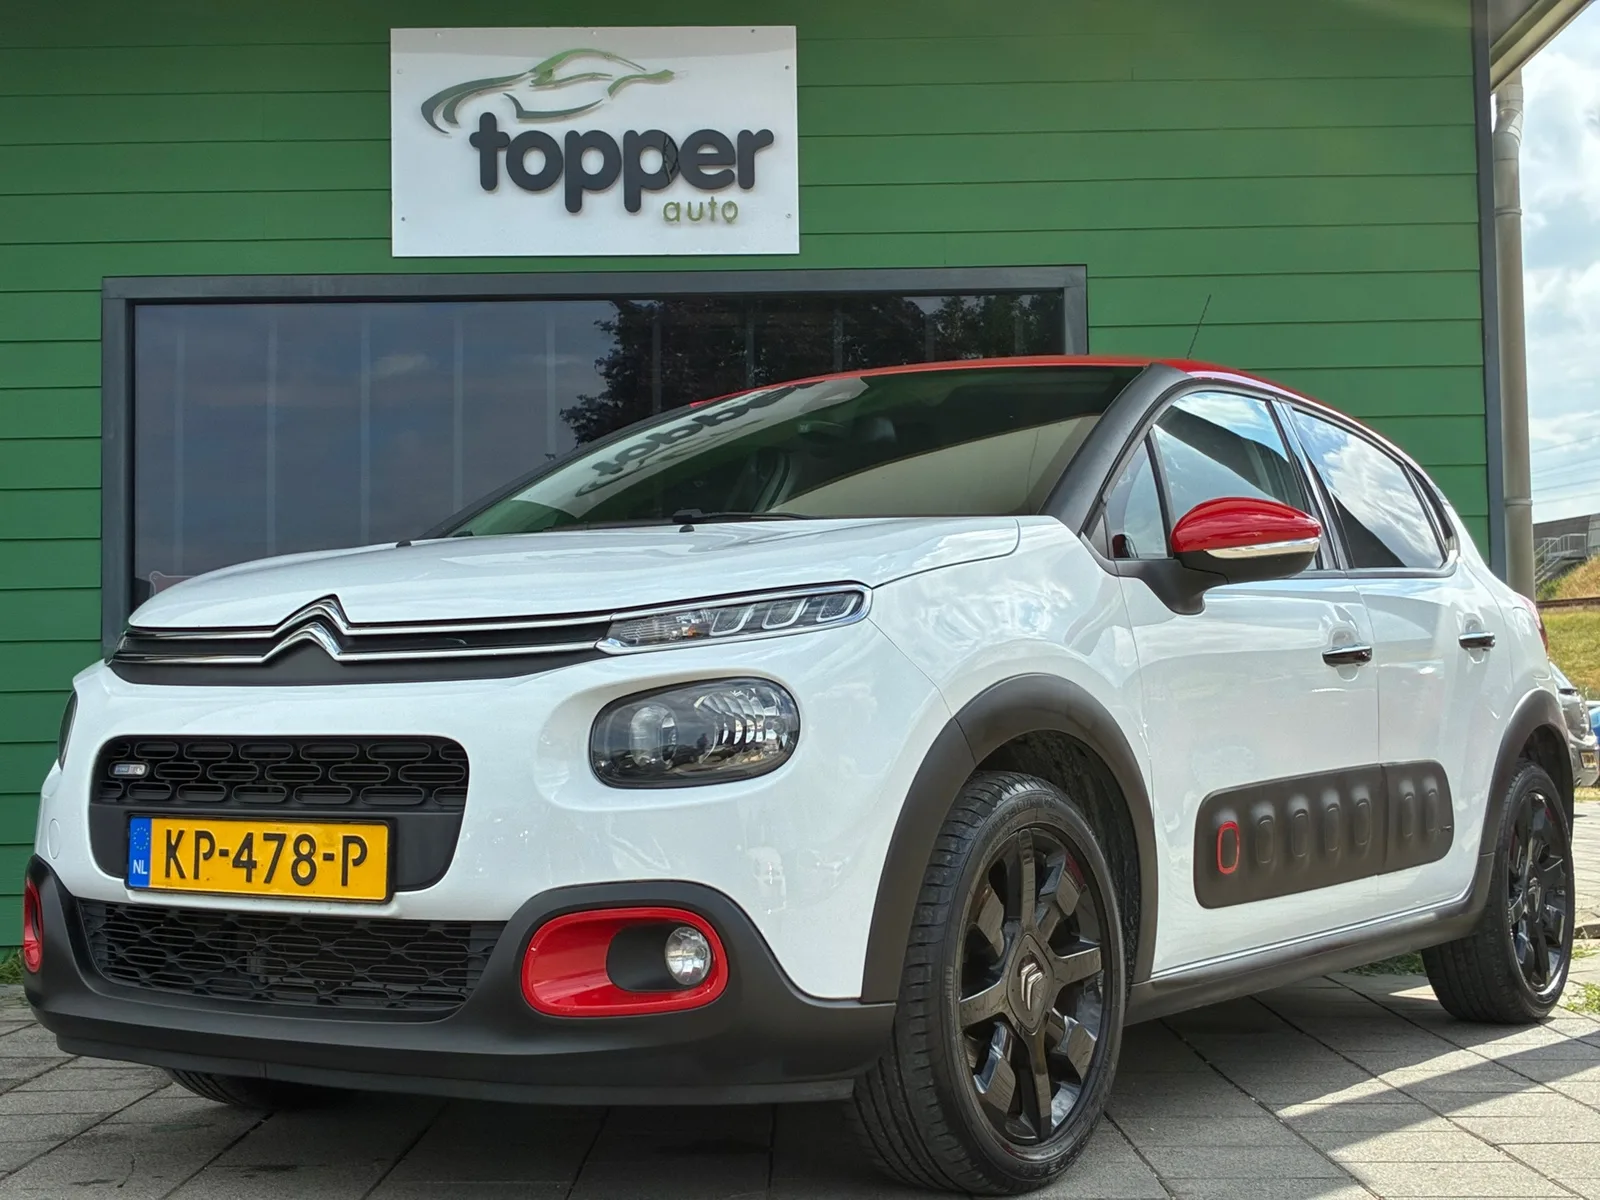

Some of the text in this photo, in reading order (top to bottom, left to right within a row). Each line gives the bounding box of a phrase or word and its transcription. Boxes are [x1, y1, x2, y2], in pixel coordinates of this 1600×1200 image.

[469, 112, 774, 213] topper
[663, 196, 739, 223] auto
[132, 859, 148, 875] NL
[164, 829, 368, 887] KP-478-P
